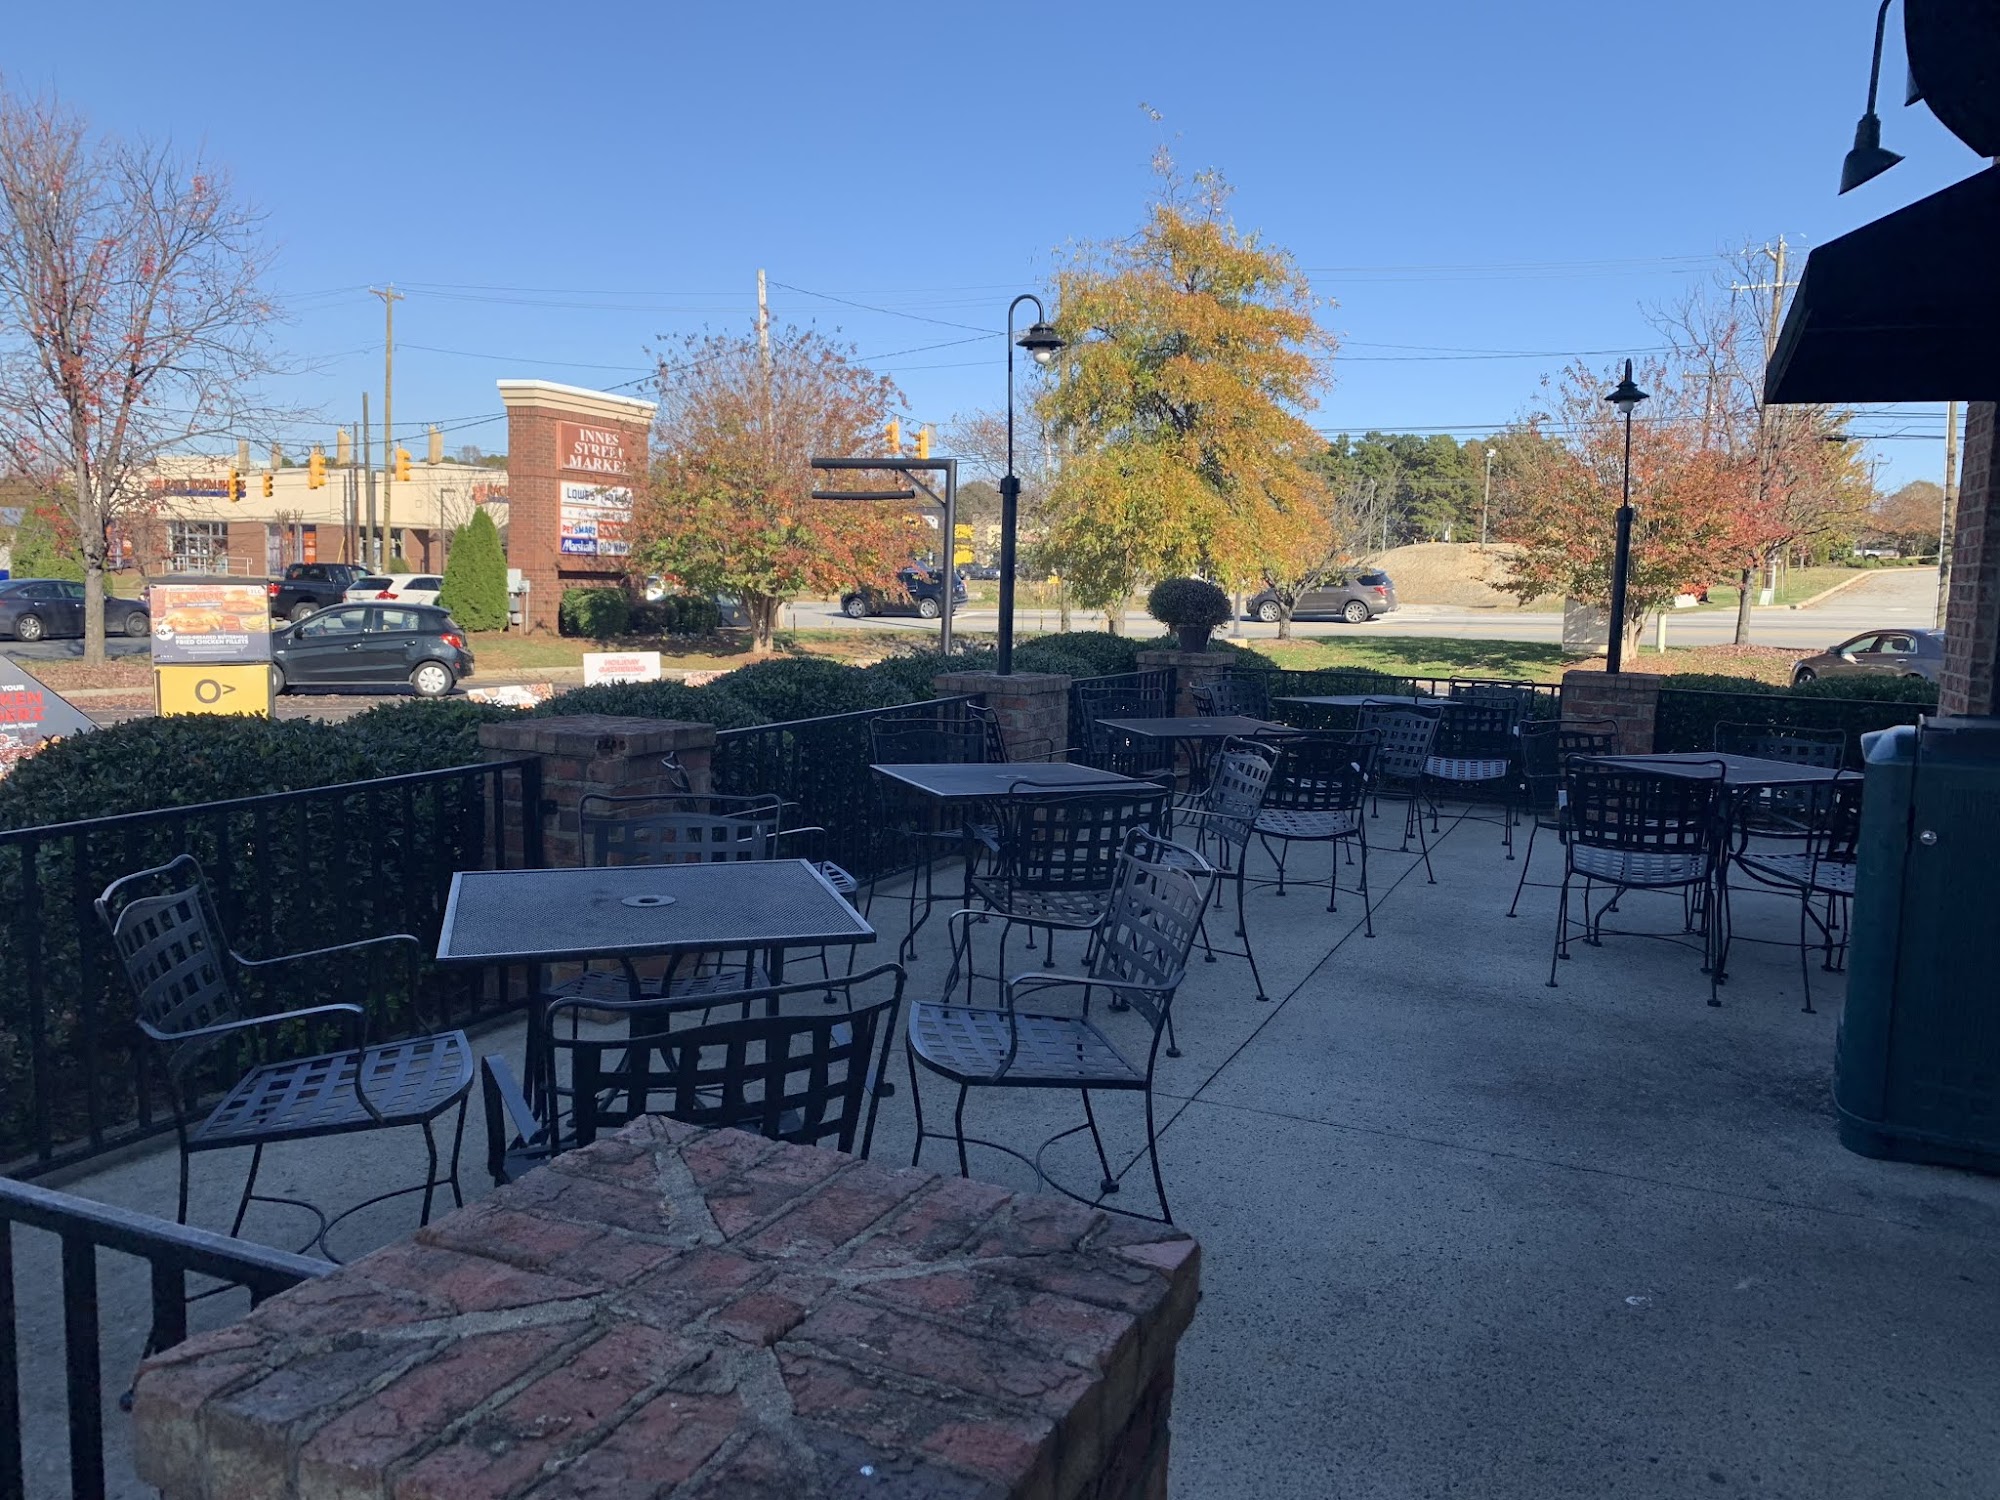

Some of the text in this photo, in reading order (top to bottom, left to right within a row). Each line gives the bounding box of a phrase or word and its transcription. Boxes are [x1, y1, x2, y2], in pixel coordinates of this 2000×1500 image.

[580, 428, 619, 446] INNES
[574, 441, 625, 459] STREET
[562, 539, 596, 552] Marshalls
[1, 684, 25, 692] YOUR
